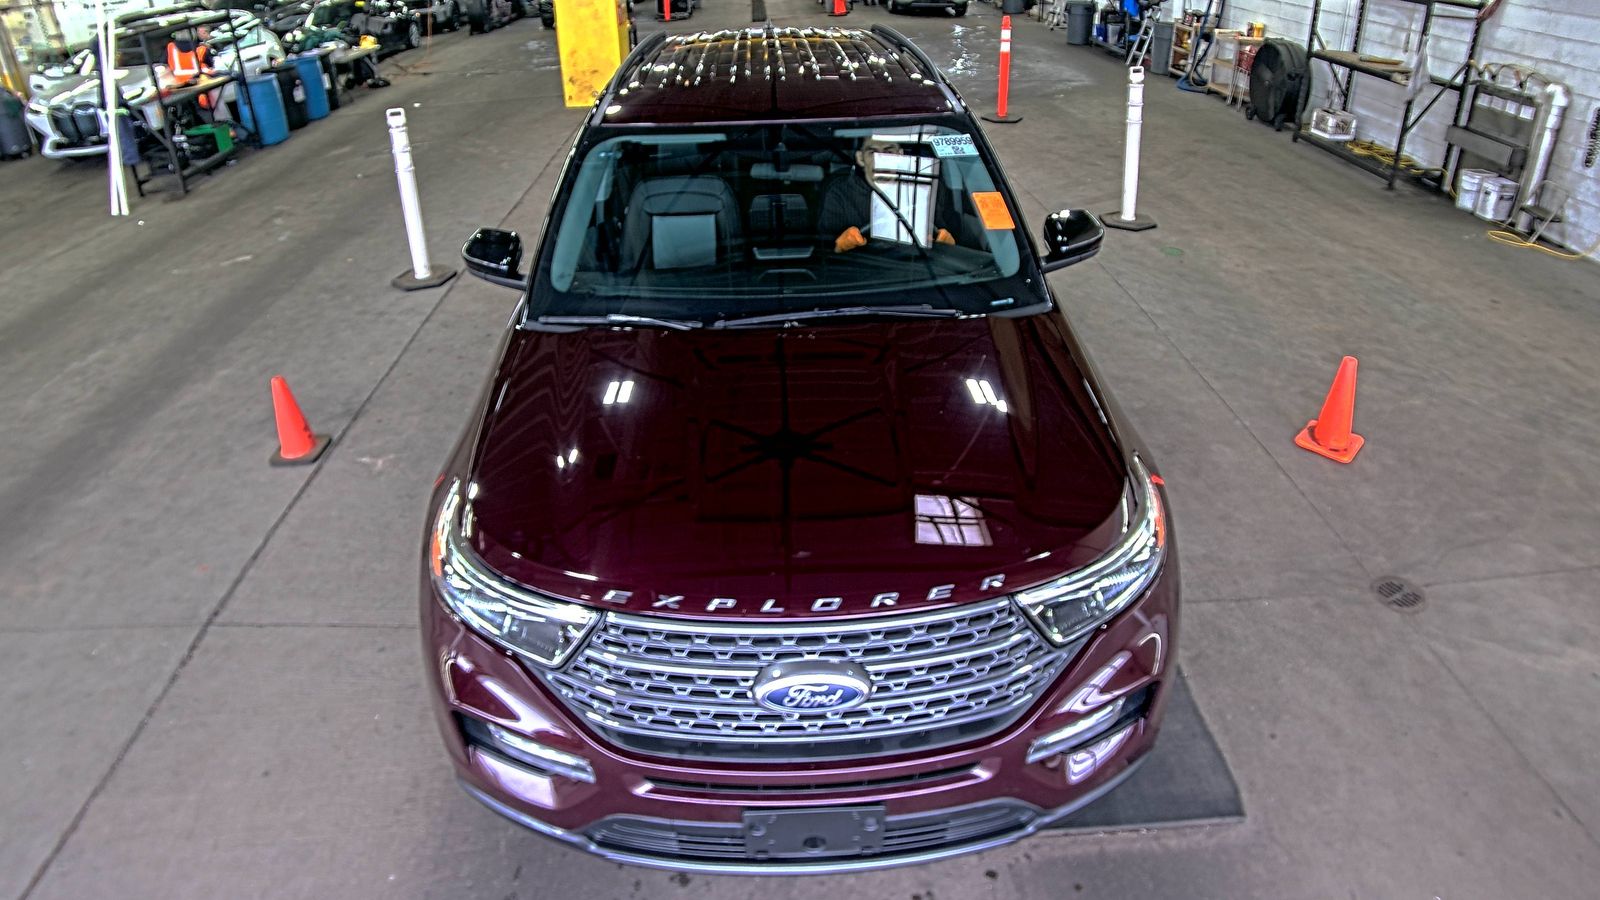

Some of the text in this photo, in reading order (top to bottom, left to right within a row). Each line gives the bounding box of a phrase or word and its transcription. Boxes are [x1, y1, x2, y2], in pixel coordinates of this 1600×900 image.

[932, 136, 972, 146] 9789959
[602, 573, 1007, 613] EXPLORER
[783, 683, 843, 708] Ford
